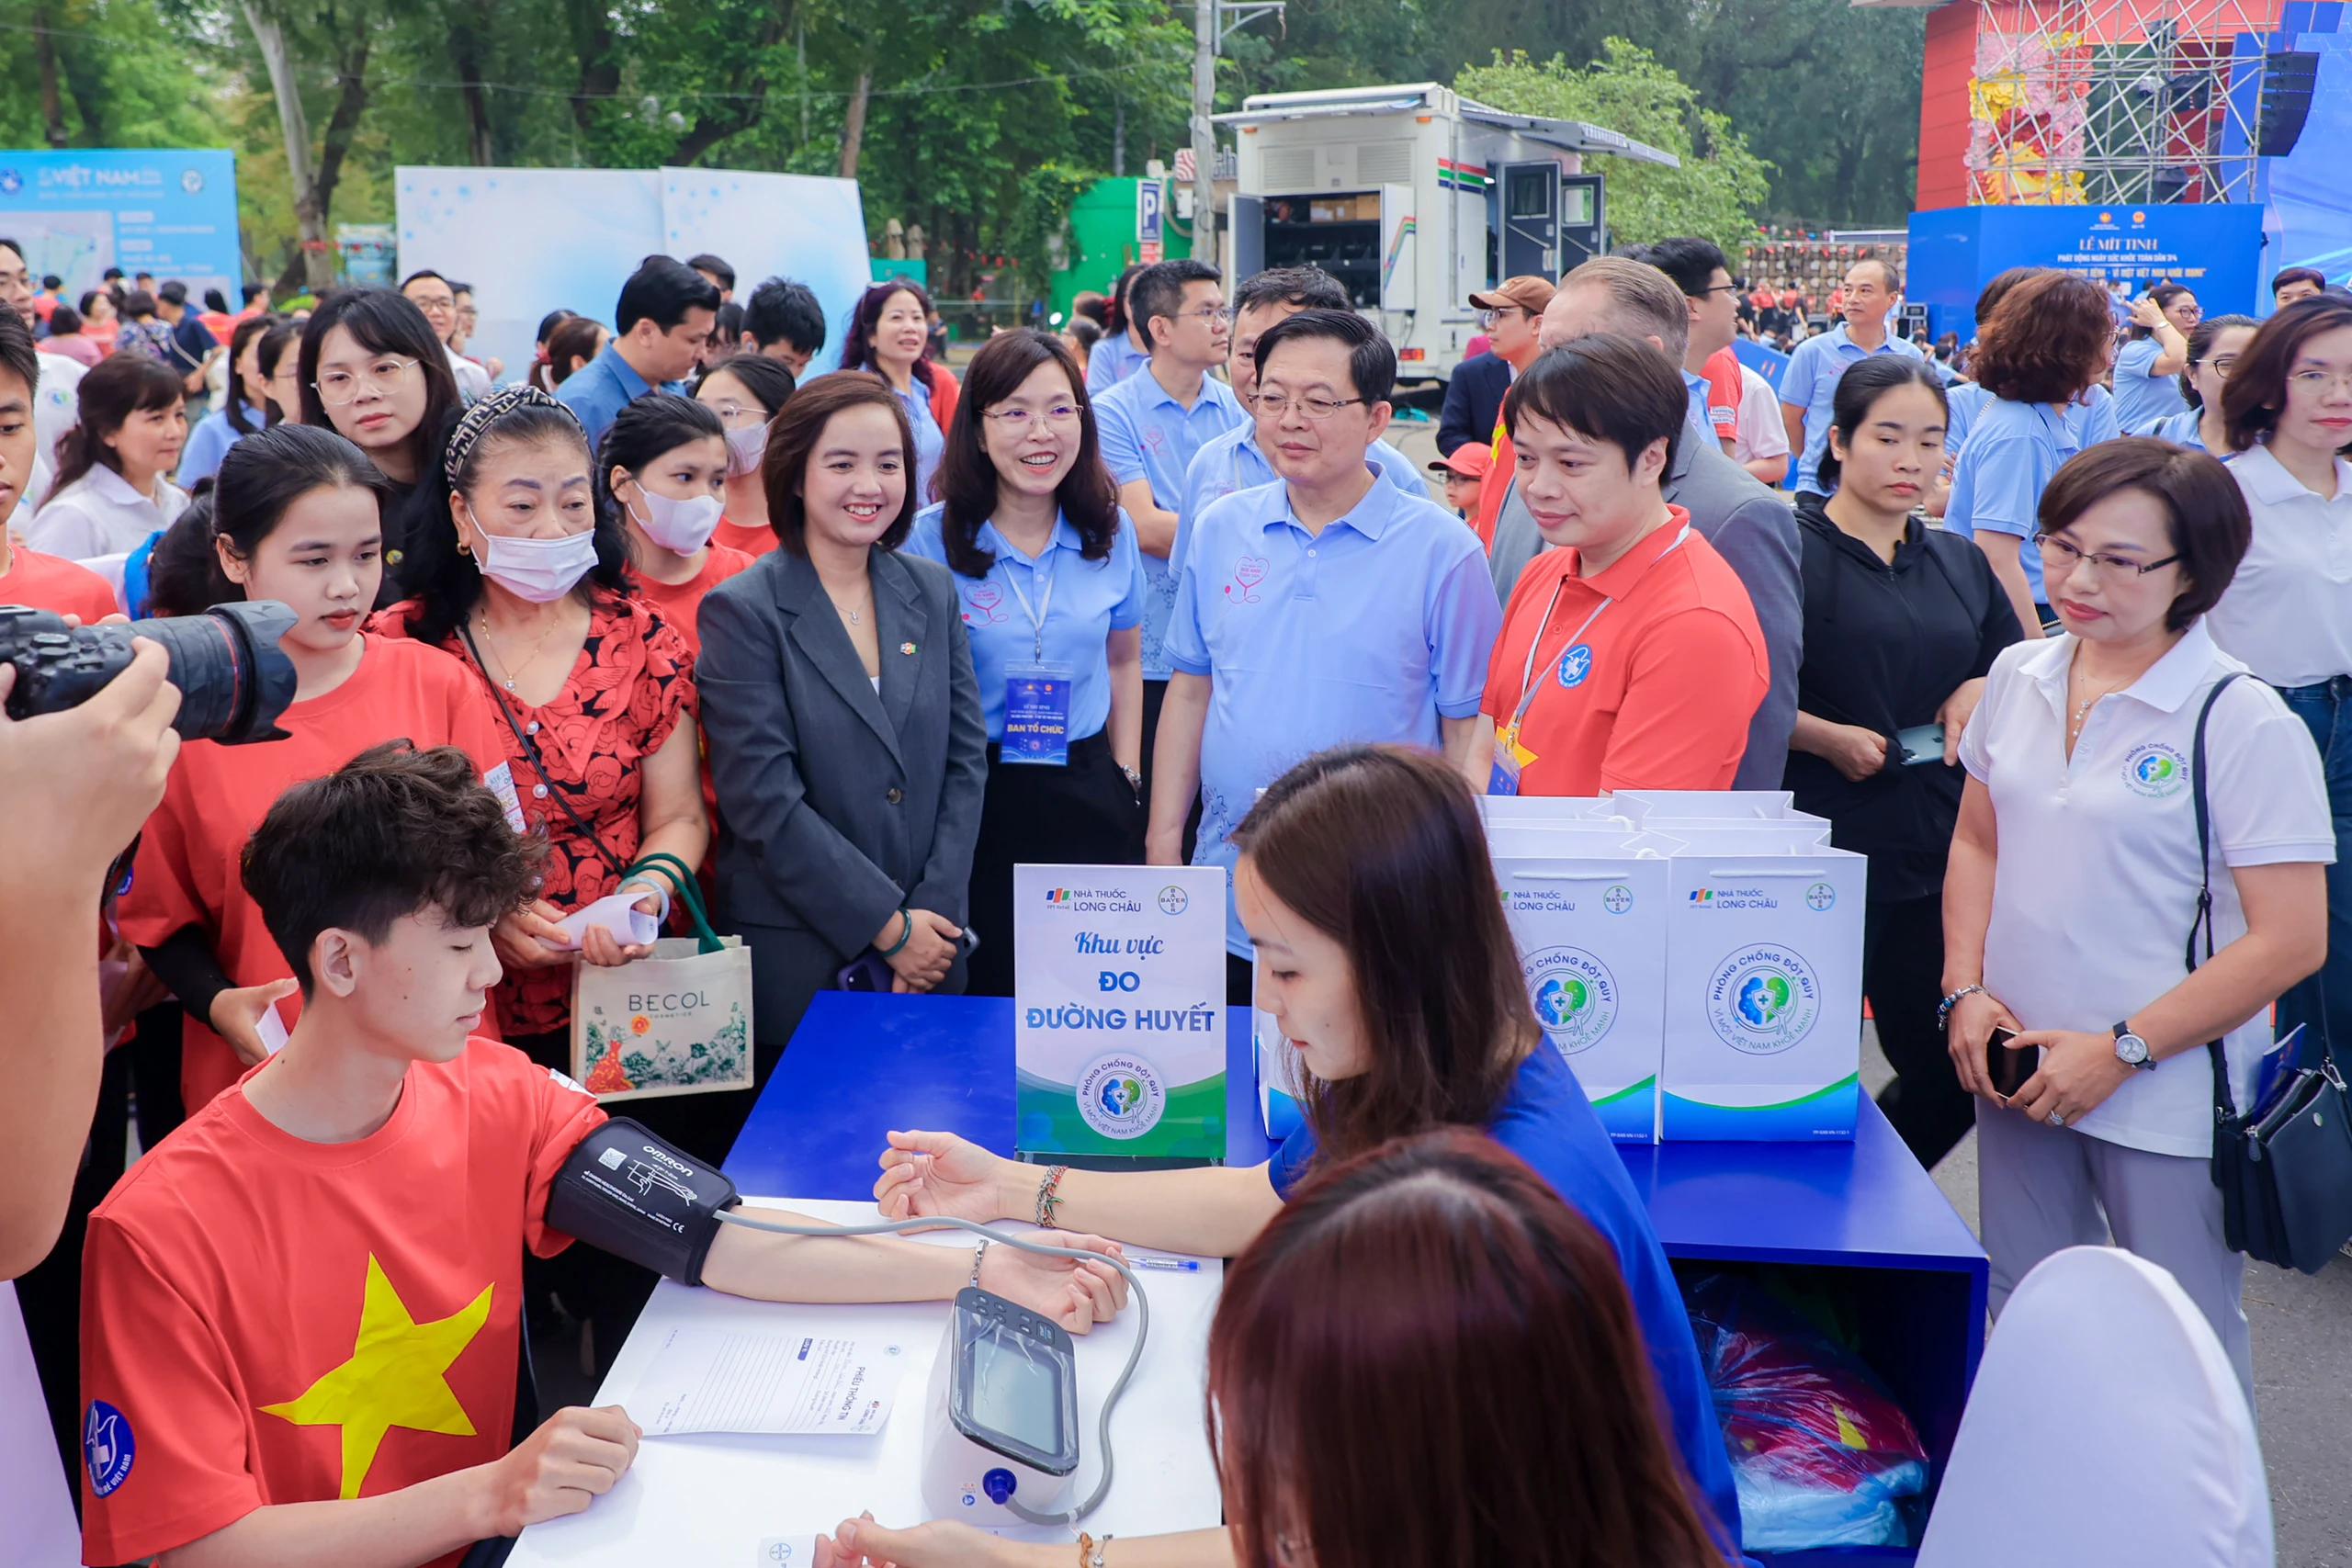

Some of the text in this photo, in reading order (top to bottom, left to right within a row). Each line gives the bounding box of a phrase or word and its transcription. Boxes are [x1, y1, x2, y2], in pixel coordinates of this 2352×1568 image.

[1143, 191, 1157, 228] P
[2079, 235, 2158, 251] LỄ MÍT TINH
[1007, 721, 1064, 734] BAN TỔ CHỨC
[1074, 887, 1126, 898] NHÀ THUỐC
[1514, 889, 1561, 899] NHÀ THUỐC
[1717, 887, 1764, 897] NHÀ THUỐC
[1074, 900, 1141, 912] LONG CHÂU
[1513, 899, 1576, 911] LONG CHÂU
[1717, 897, 1778, 910] LONG CHÂU
[1074, 931, 1165, 961] Khu vực
[1536, 952, 1578, 968] CHỐNG
[1581, 961, 1602, 979] ĐỘT
[1713, 964, 1737, 1000] PHÒNG
[1738, 949, 1781, 966] CHỐNG
[1782, 958, 1804, 976] ĐỘT
[1098, 971, 1140, 992] ĐO
[628, 990, 710, 1011] BECOL
[1025, 1001, 1216, 1032] ĐƯỜNG HUYẾT
[1748, 1041, 1771, 1050] NAM
[1082, 1068, 1101, 1096] PHÒNG
[1101, 1058, 1134, 1071] CHỐNG
[1135, 1066, 1151, 1079] ĐỘT
[643, 1145, 694, 1177] OMRON
[837, 1367, 865, 1420] PHIẾU THÔNG TIN
[110, 1471, 124, 1486] VIỆT
[119, 1453, 131, 1472] NAM
